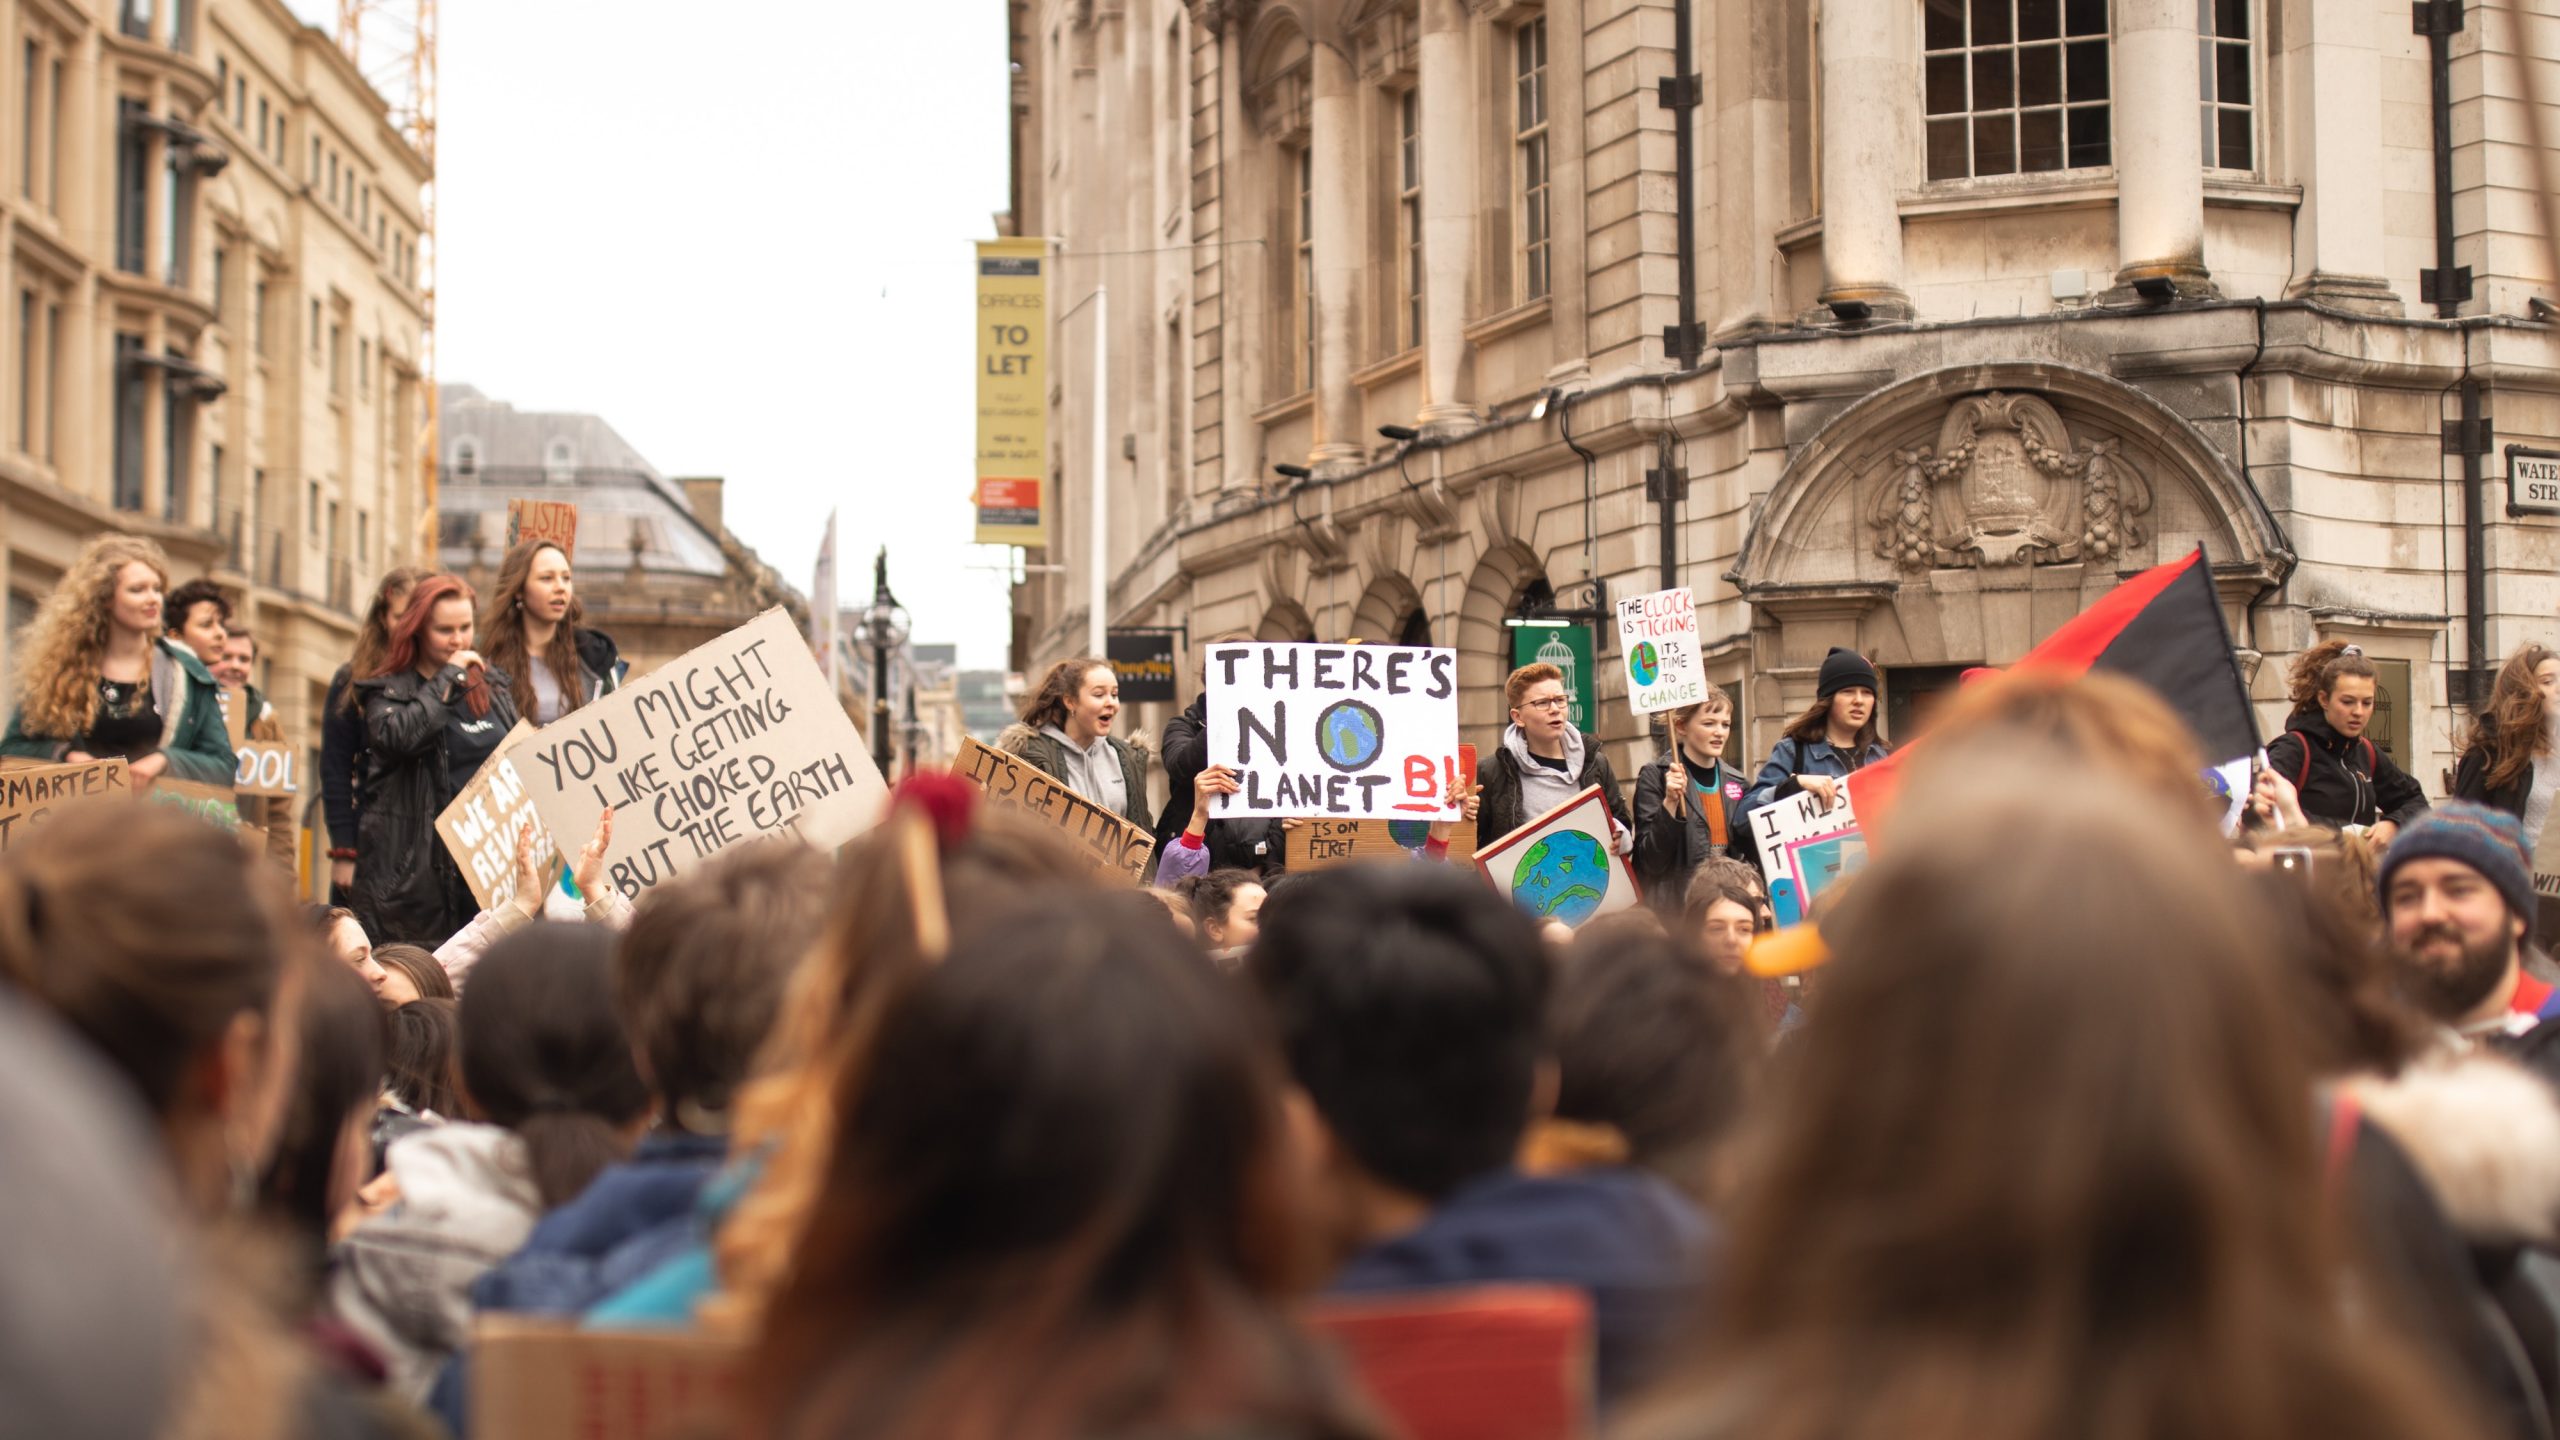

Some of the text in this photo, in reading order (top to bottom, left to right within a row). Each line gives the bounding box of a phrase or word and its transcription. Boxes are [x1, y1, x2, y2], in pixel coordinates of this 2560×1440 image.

[991, 325, 1029, 345] TO
[987, 354, 1032, 375] LET
[2517, 461, 2560, 480] WATE
[1619, 591, 1693, 617] THE CLOCK
[1636, 615, 1695, 638] TICKING
[1661, 641, 1679, 655] IT'S
[1661, 653, 1687, 669] TIME
[1215, 647, 1452, 699] THERE'S
[1662, 673, 1677, 683] TO
[1640, 682, 1697, 708] CHANGE
[536, 719, 617, 791] YOU
[634, 639, 771, 740] MIGHT
[592, 687, 792, 811] LIKE GETTING
[235, 747, 297, 791] OOL
[451, 795, 497, 848] WE
[488, 758, 524, 814] AR
[654, 755, 775, 832] CHOKED
[966, 745, 1019, 796] IT'S
[1024, 777, 1152, 876] GETTING
[1760, 784, 1847, 839] I WIS
[609, 838, 677, 901] BUT
[679, 806, 743, 859] THE
[747, 752, 854, 830] EARTH
[1312, 821, 1359, 838] IS ON
[1310, 839, 1354, 860] FIRE!
